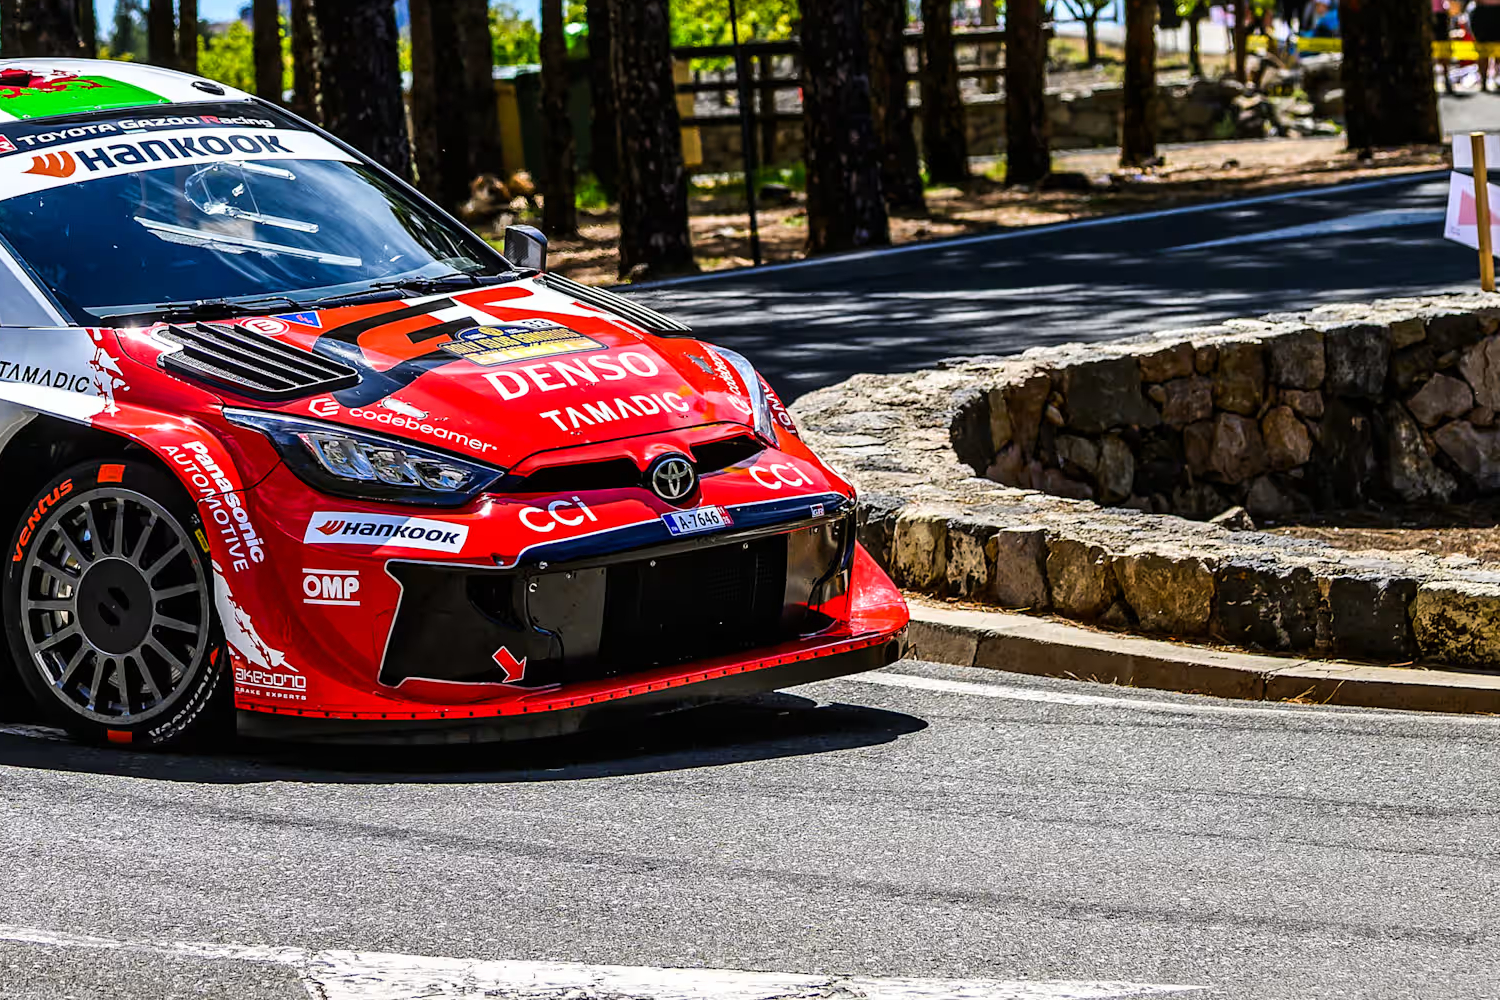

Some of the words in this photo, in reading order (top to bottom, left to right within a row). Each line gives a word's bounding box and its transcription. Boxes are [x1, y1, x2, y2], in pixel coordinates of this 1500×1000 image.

[17, 123, 116, 146] TOYOTA
[118, 116, 198, 131] GAZOO
[200, 114, 275, 128] Racing
[0, 361, 91, 393] TAMADIC
[480, 349, 661, 402] DENSO
[540, 389, 691, 432] TAMADIC
[348, 407, 495, 452] codebeamer
[160, 445, 249, 573] AUTOMOTIVE
[181, 440, 265, 564] Panasonic
[678, 510, 720, 530] A-7646
[303, 574, 360, 600] OMP
[235, 686, 261, 696] BRAKE
[266, 690, 307, 701] EXPERTS
